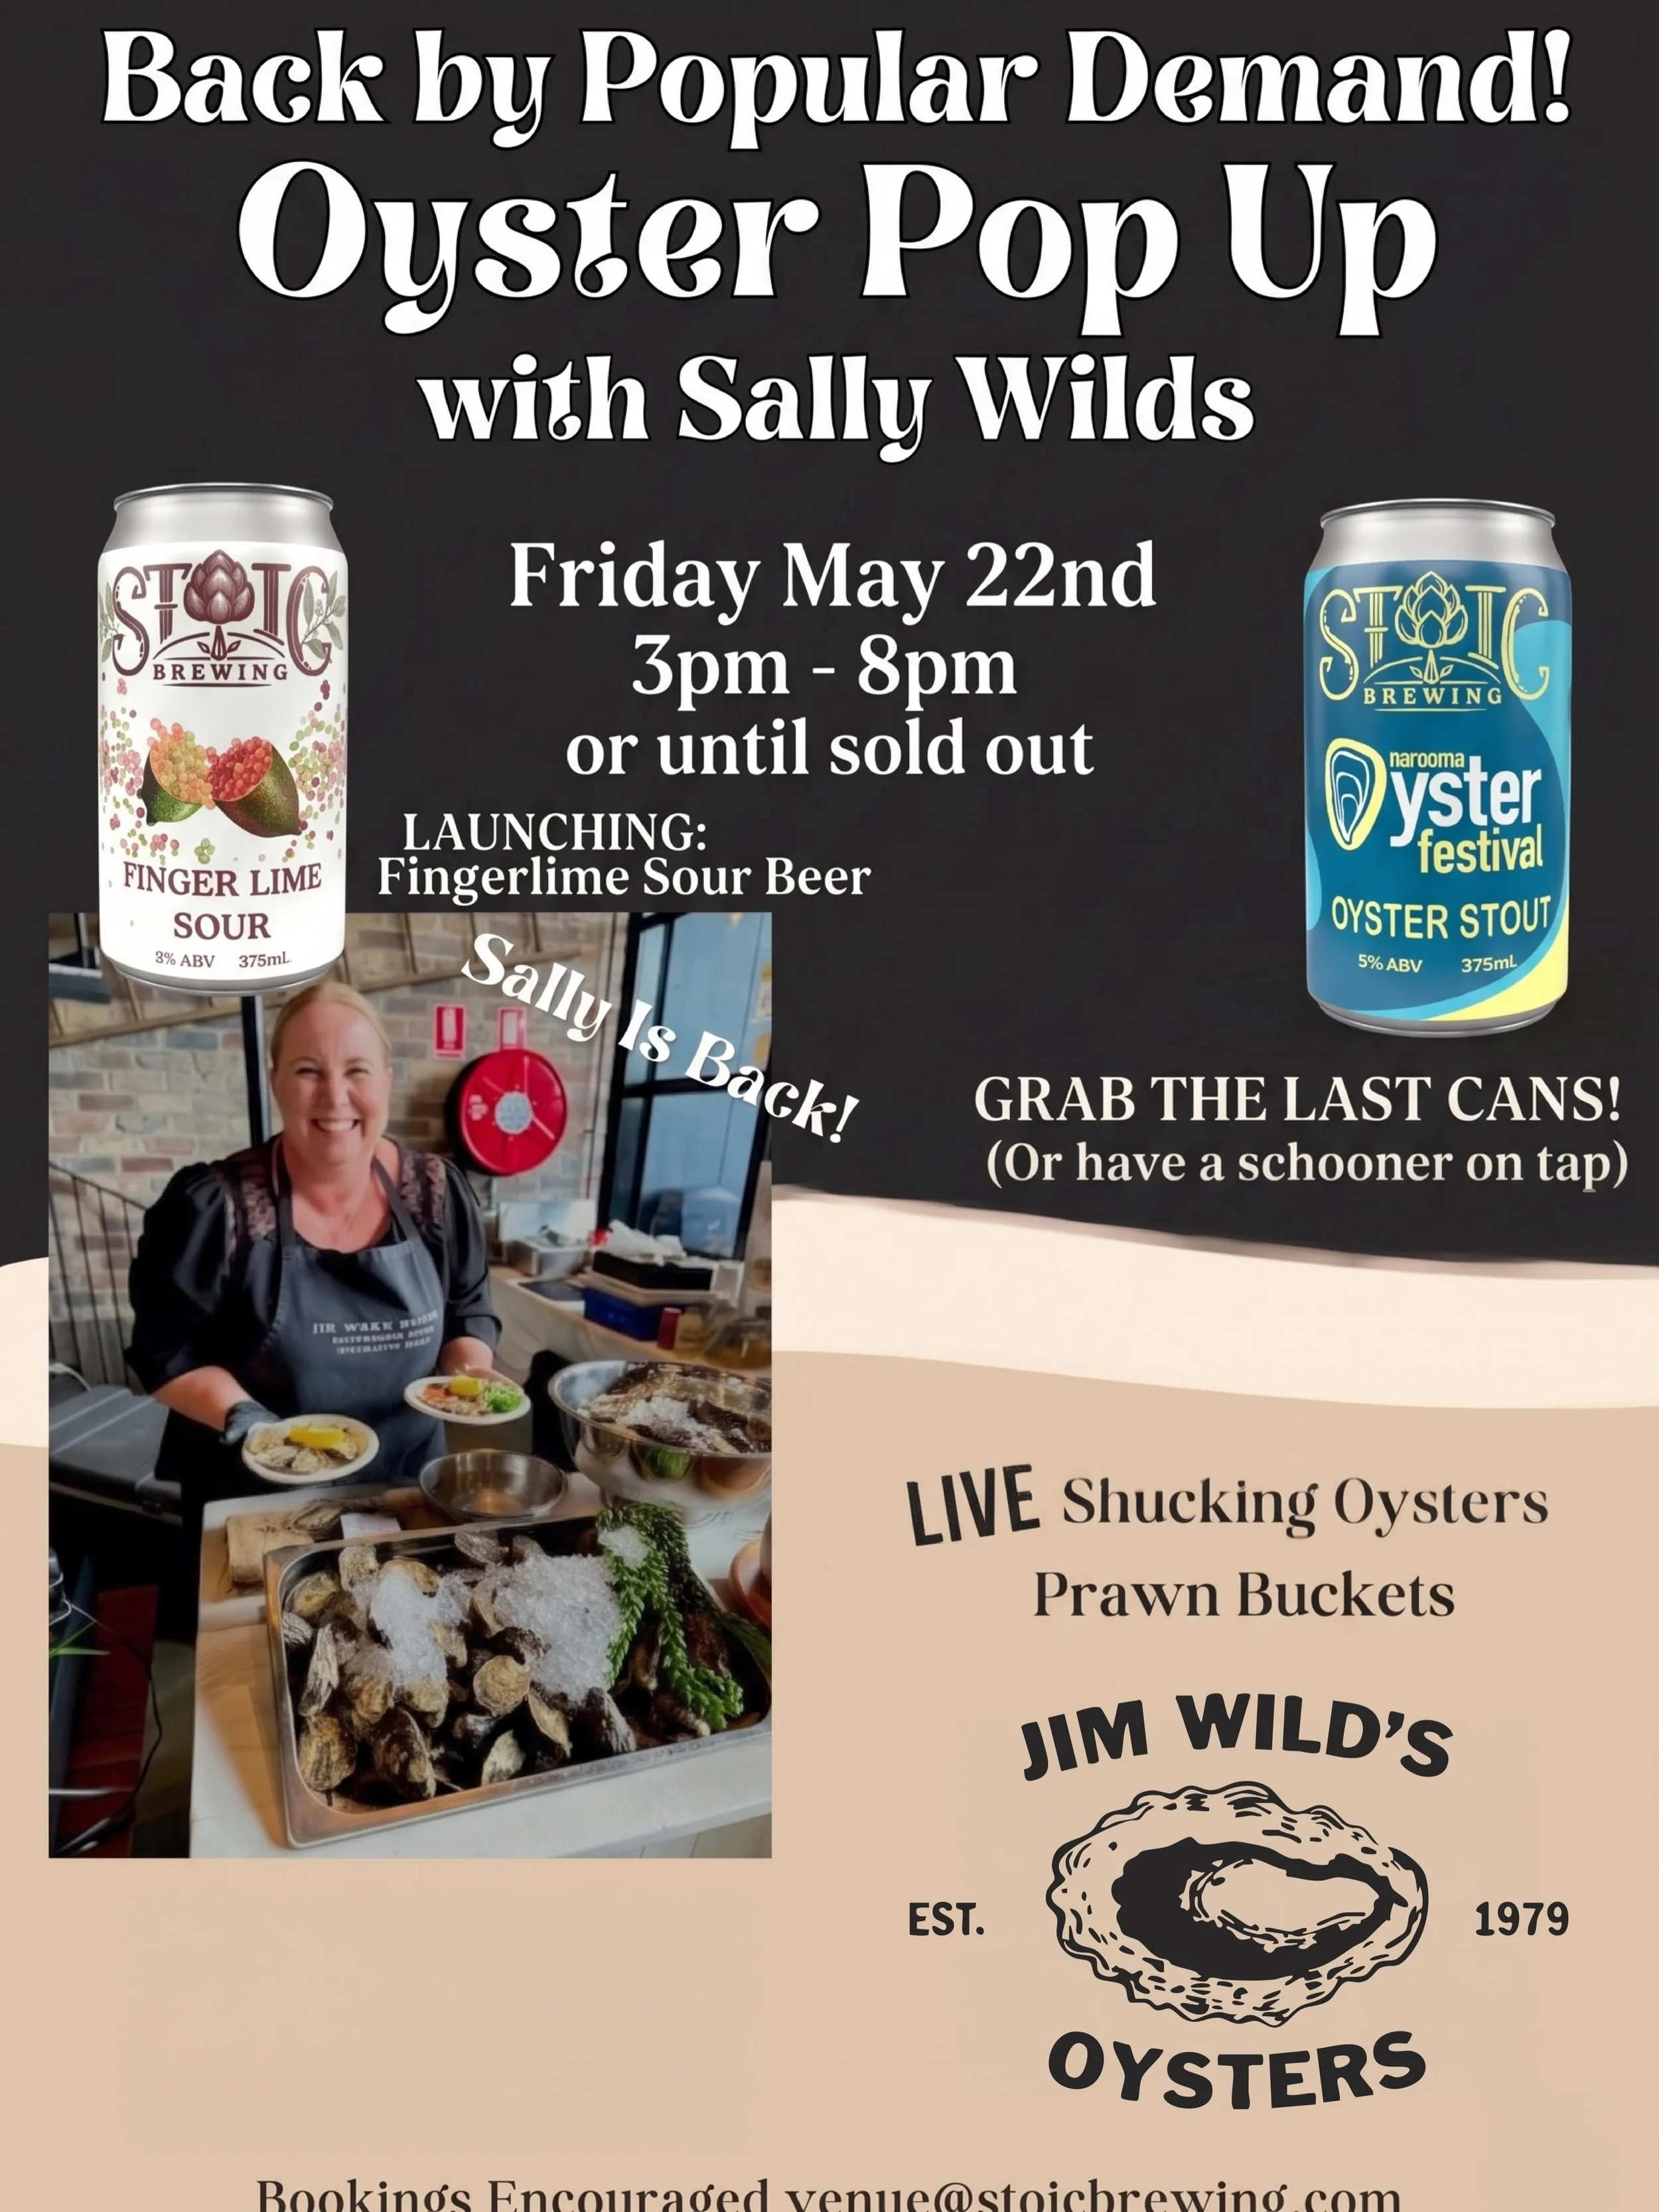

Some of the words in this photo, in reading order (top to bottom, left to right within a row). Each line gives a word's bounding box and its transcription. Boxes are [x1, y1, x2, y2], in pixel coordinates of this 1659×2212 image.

[102, 29, 385, 125] Back
[414, 29, 548, 147] by
[581, 29, 1040, 149] Popular
[1066, 28, 1571, 125] Demand!
[238, 160, 820, 334] Oyster
[861, 163, 1179, 336] Pop
[1222, 163, 1437, 336] Up
[416, 353, 650, 441] with
[678, 354, 934, 464] Sally
[954, 353, 1255, 441] Wilds
[510, 540, 761, 626] Friday
[782, 542, 946, 626] May
[966, 540, 1157, 607] 22nd
[113, 550, 332, 676] STOIC
[1319, 571, 1550, 700] STOIC
[153, 664, 288, 680] BREWING
[632, 634, 790, 711] 3pm
[812, 666, 835, 675] -
[858, 634, 1017, 711] 8pm
[1363, 688, 1502, 704] BREWING
[567, 735, 638, 775] or
[656, 717, 809, 775] until
[830, 717, 966, 775] sold
[986, 723, 1094, 775] out
[1390, 751, 1465, 768] narooma
[403, 812, 706, 851] LAUNCHING:
[1417, 824, 1543, 873] festival
[123, 861, 240, 897] FINGER
[250, 863, 323, 897] LIME
[378, 855, 629, 906] Fingerlime
[644, 857, 752, 895] Sour
[766, 857, 872, 895] Beer
[174, 913, 271, 940] SOUR
[1332, 896, 1448, 939] OYSTER
[1459, 896, 1551, 938] STOUT
[155, 951, 176, 966] 3%
[180, 954, 215, 968] ABV
[239, 952, 290, 968] 375mL
[1358, 954, 1384, 970] 5%
[1386, 958, 1423, 972] ABV
[1461, 957, 1518, 973] 375mL
[461, 933, 613, 1042] Sally
[618, 999, 676, 1062] Is
[685, 1031, 859, 1143] Back!
[975, 1076, 1135, 1122] GRAB
[1151, 1076, 1267, 1121] THE
[1283, 1076, 1431, 1121] LAST
[1448, 1076, 1619, 1122] CANS!
[987, 1140, 1062, 1189] (Or
[1076, 1141, 1185, 1181] have
[1200, 1153, 1225, 1181] a
[1238, 1142, 1453, 1181] schooner
[1467, 1153, 1524, 1181] on
[1537, 1140, 1628, 1192] tap)
[906, 1464, 1041, 1546] LIVE
[1063, 1477, 1319, 1538] Shucking
[1334, 1477, 1549, 1538] Oysters
[1034, 1572, 1220, 1617] Prawn
[1238, 1570, 1455, 1617] Buckets
[1021, 1699, 1148, 1781] JIM
[1175, 1692, 1453, 1777] WILD'S
[909, 1902, 985, 1937] EST.
[1475, 1901, 1569, 1937] 1979
[1048, 2031, 1426, 2110] OYSTERS
[256, 2178, 472, 2212] Bookings
[488, 2177, 768, 2212] Encouraged
[784, 2178, 1401, 2212] venue@stoicbrewingcom
